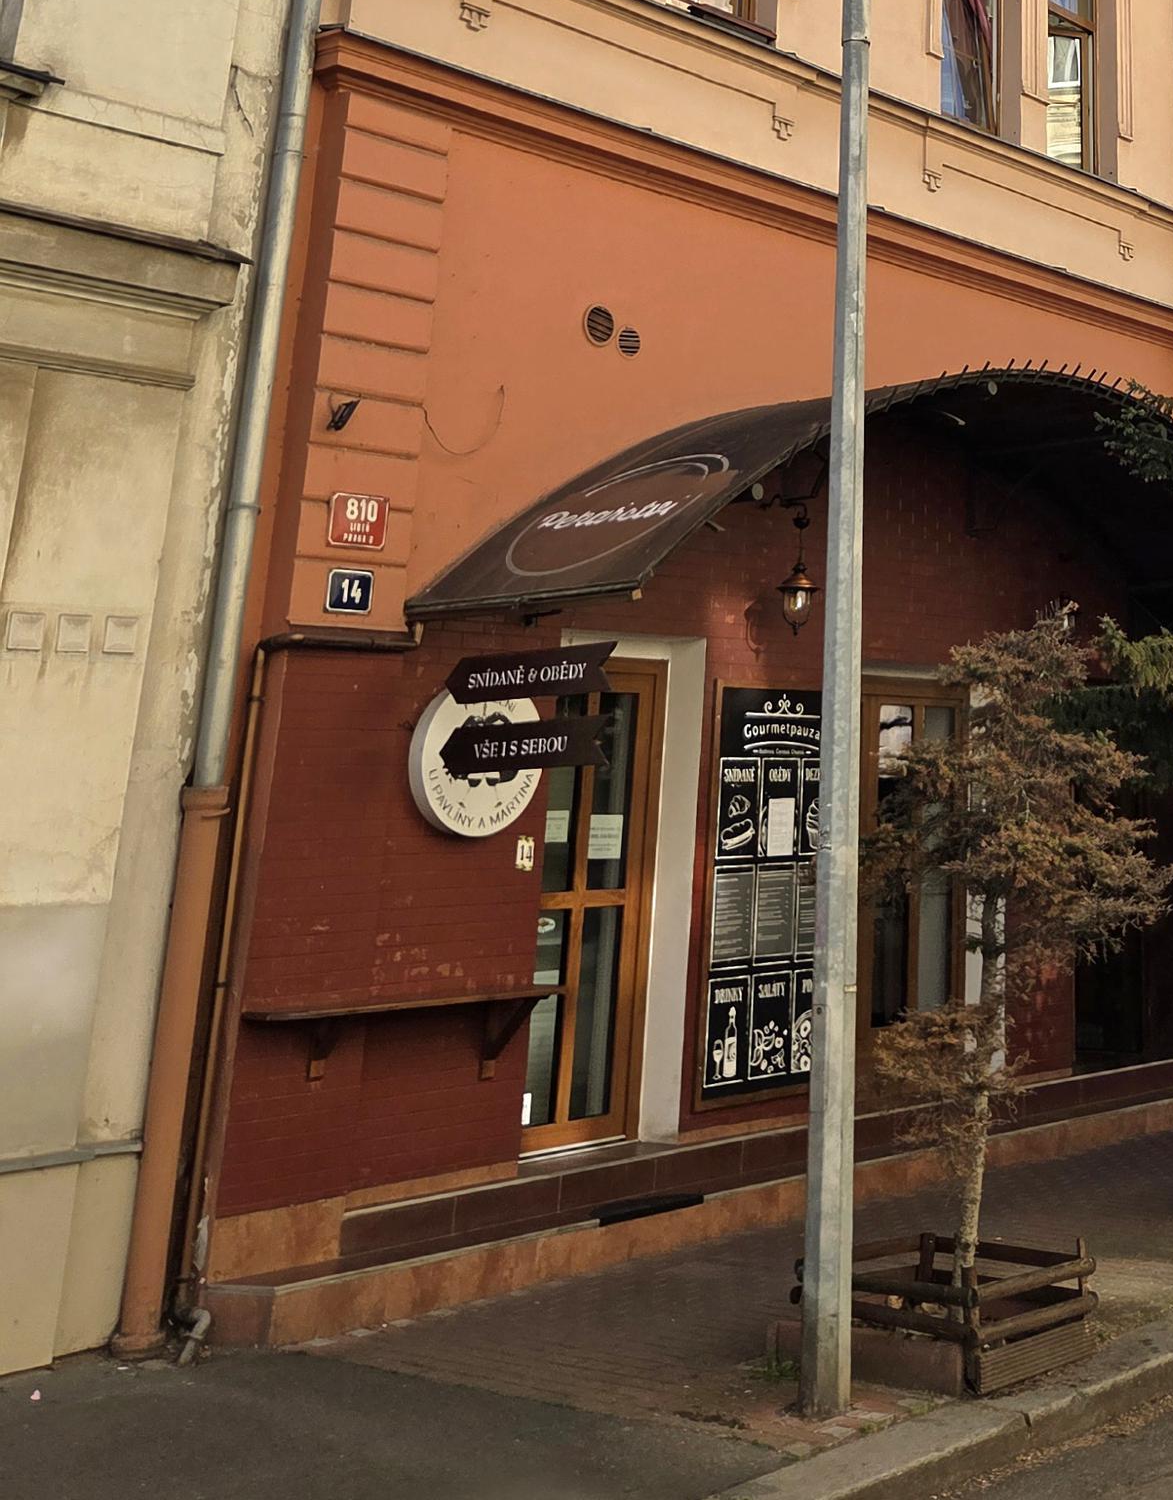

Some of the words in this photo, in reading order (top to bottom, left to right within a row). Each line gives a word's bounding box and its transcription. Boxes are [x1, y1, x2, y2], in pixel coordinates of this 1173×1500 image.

[346, 498, 378, 522] 810
[341, 578, 362, 604] 14
[468, 665, 525, 689] SNÍDANĚ
[527, 667, 538, 683] &
[540, 660, 588, 682] OBĚDY
[743, 723, 820, 741] Gourmetpauza
[474, 739, 498, 759] VŠE
[509, 740, 518, 757] S
[520, 736, 568, 755] SEBOU
[428, 768, 438, 780] U
[432, 784, 475, 828] PAVLÍNY
[489, 773, 535, 827] MARTINA
[478, 817, 486, 829] A
